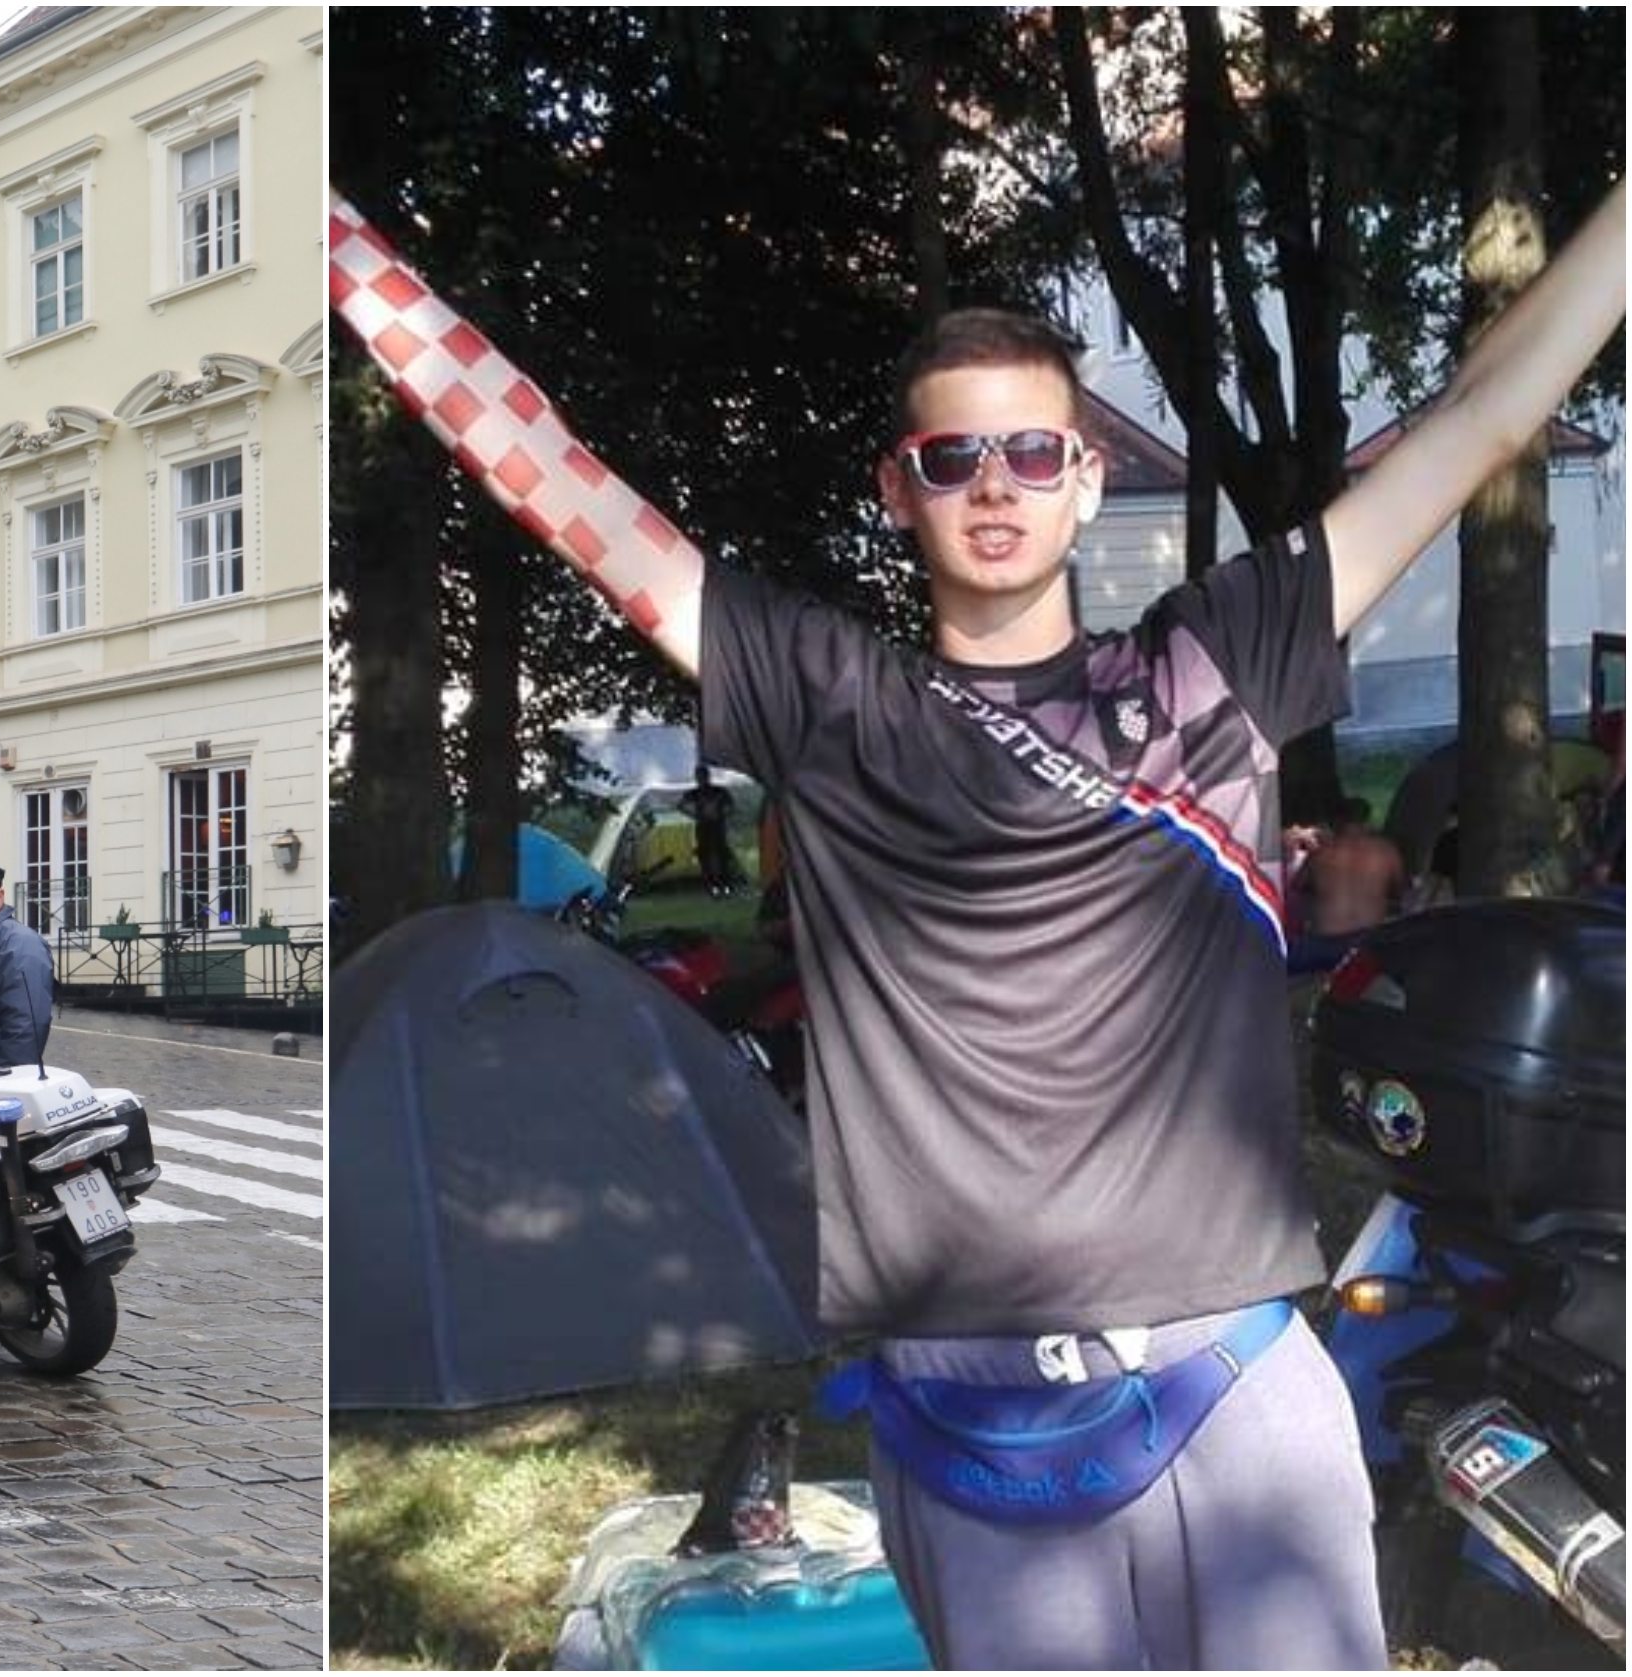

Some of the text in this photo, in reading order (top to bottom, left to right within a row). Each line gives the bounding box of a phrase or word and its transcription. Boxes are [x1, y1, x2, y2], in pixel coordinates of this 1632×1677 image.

[46, 1095, 98, 1122] POLICIJA
[66, 1176, 100, 1201] 190
[86, 1209, 118, 1233] 406
